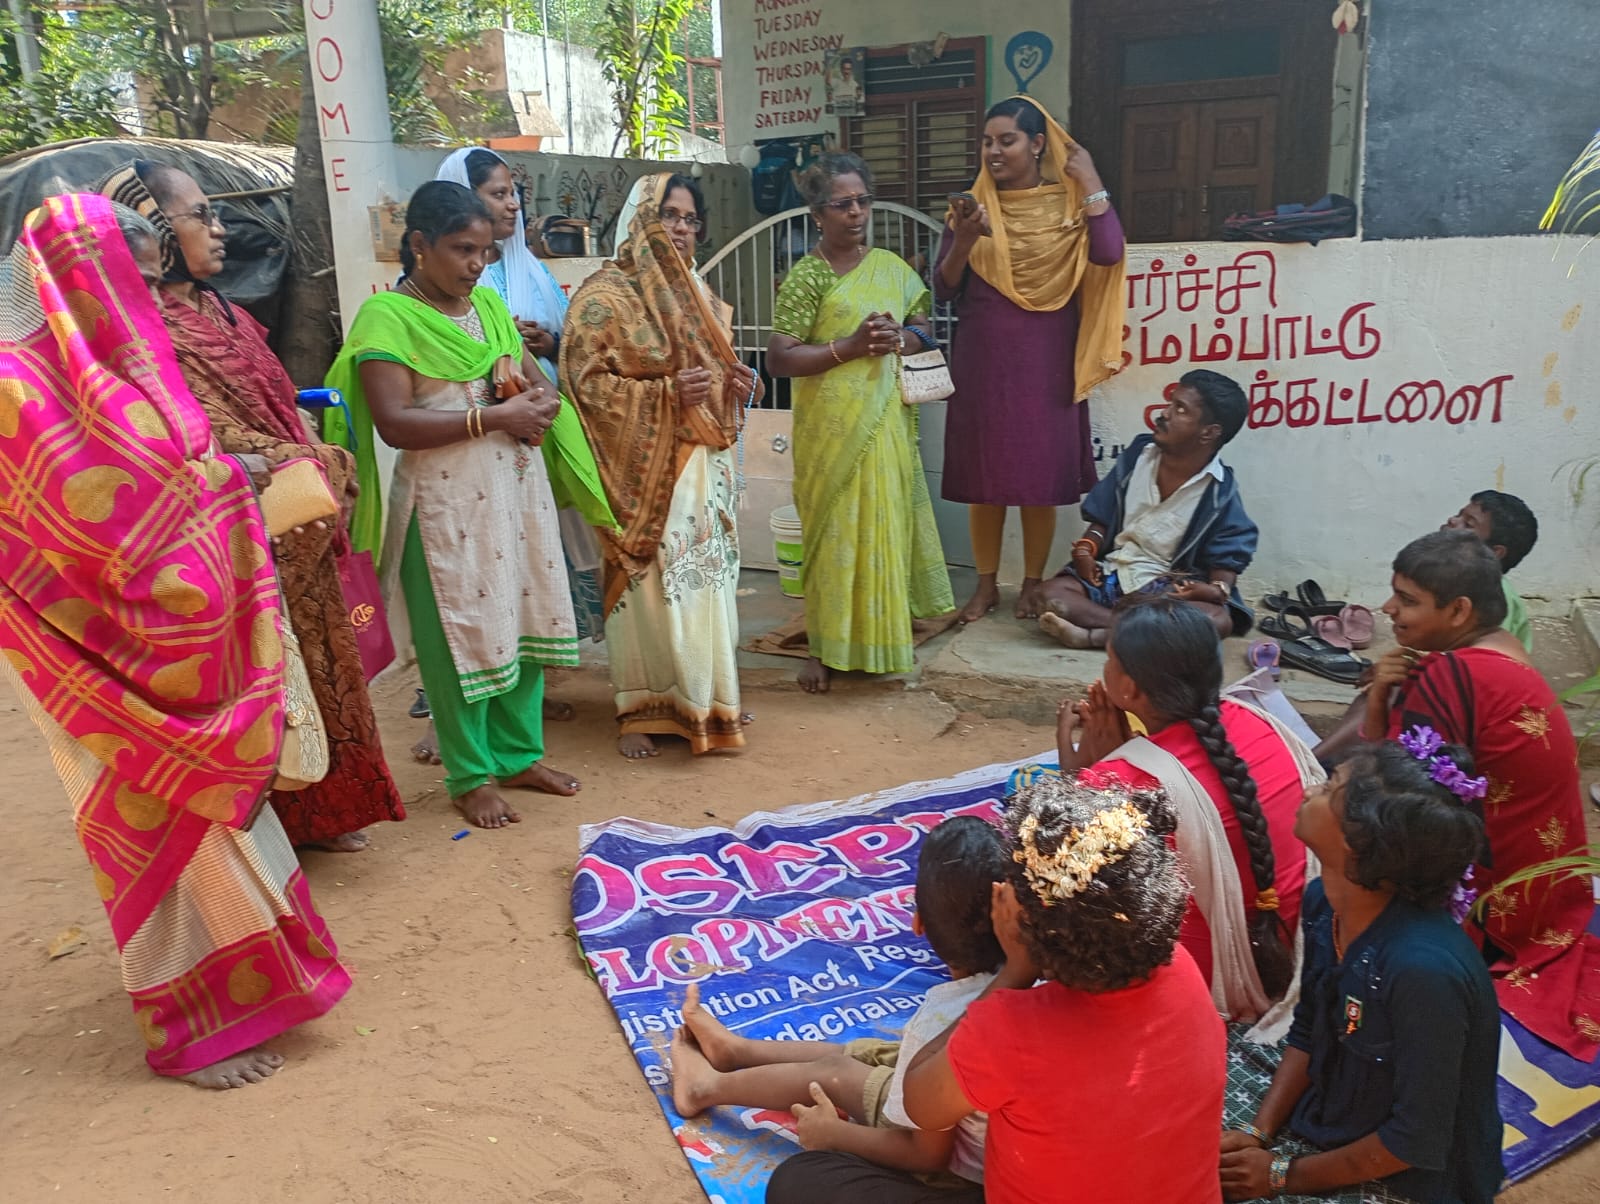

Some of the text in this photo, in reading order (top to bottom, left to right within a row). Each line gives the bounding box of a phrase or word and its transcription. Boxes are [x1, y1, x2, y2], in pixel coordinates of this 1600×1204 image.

[753, 9, 822, 40] TUESDAY
[753, 34, 844, 61] WEDNESDAY
[760, 86, 812, 108] FRIDAY
[754, 106, 822, 129] SATERDAY
[570, 798, 1004, 938] OSEP
[585, 885, 917, 999] LOPMEN
[621, 986, 783, 1046] istrtion
[788, 959, 860, 999] Act,
